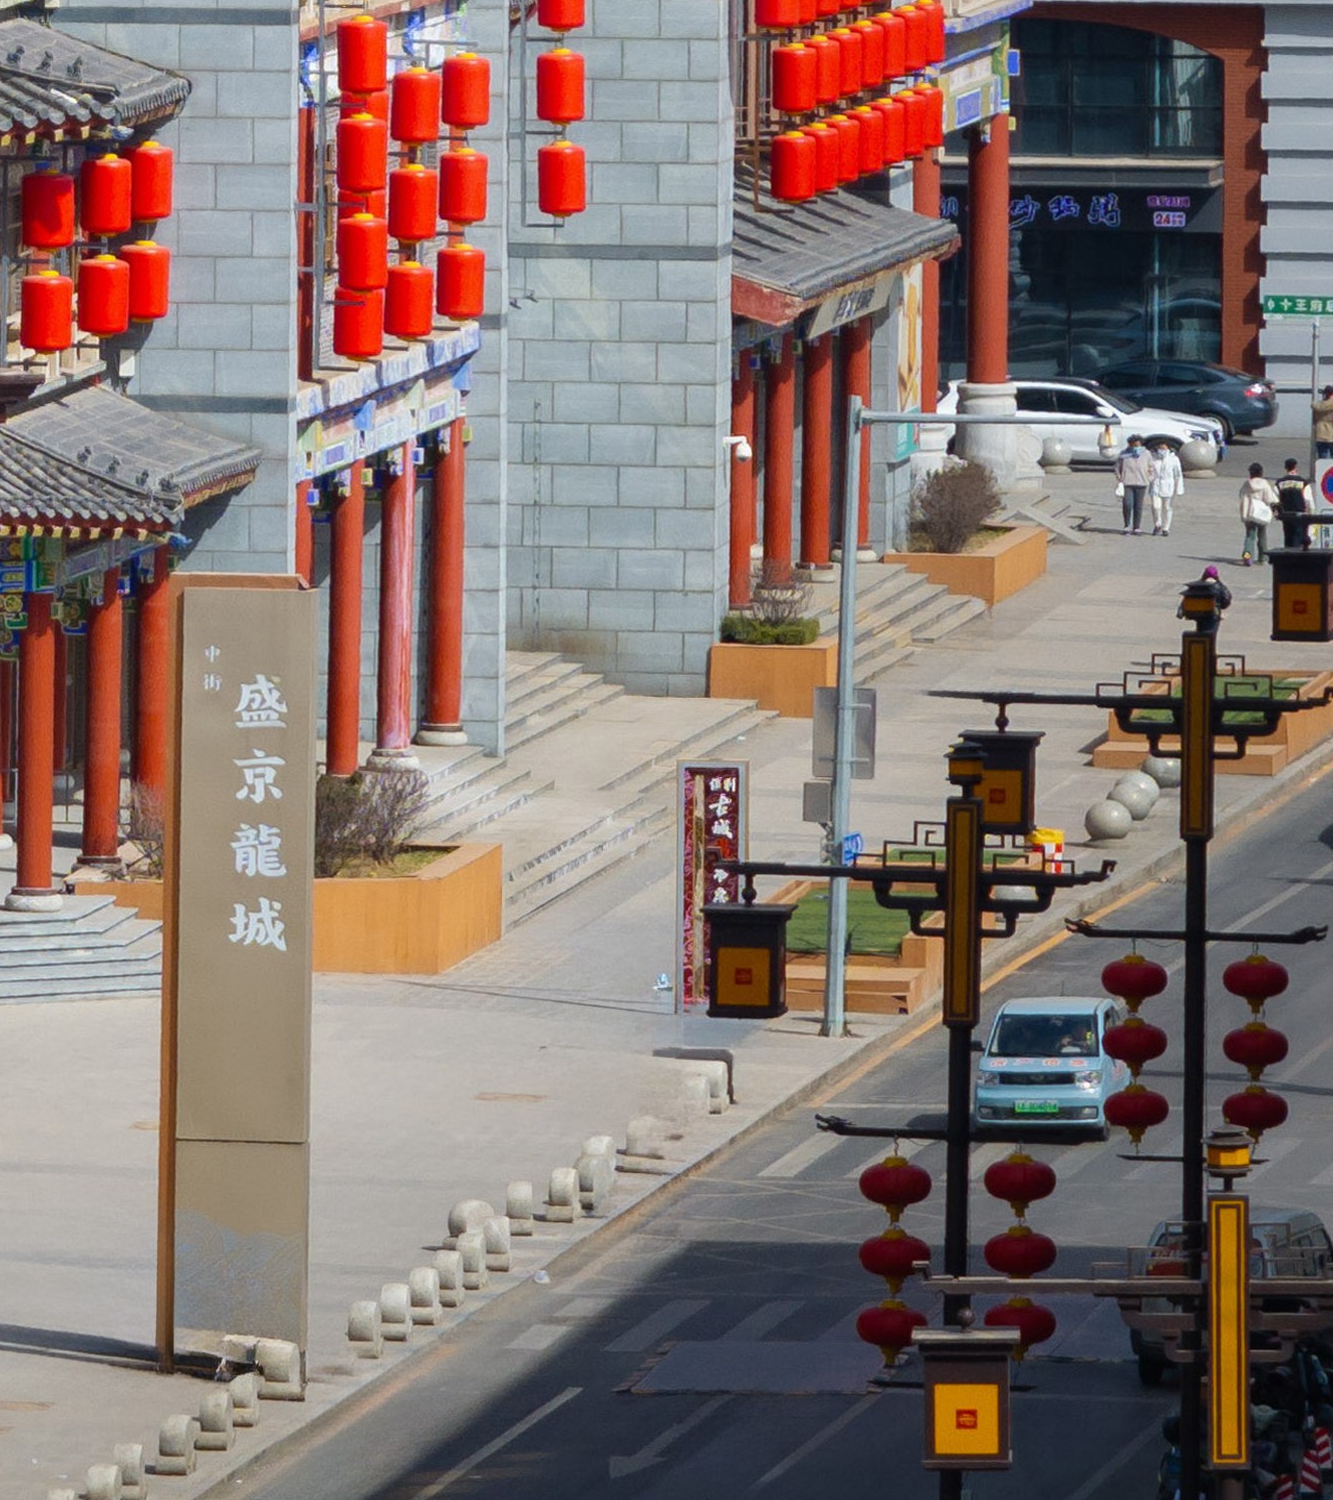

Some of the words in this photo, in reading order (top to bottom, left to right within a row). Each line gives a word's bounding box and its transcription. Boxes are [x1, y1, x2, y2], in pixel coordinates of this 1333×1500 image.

[203, 645, 222, 692] 中街
[229, 674, 288, 951] 盛京龍城
